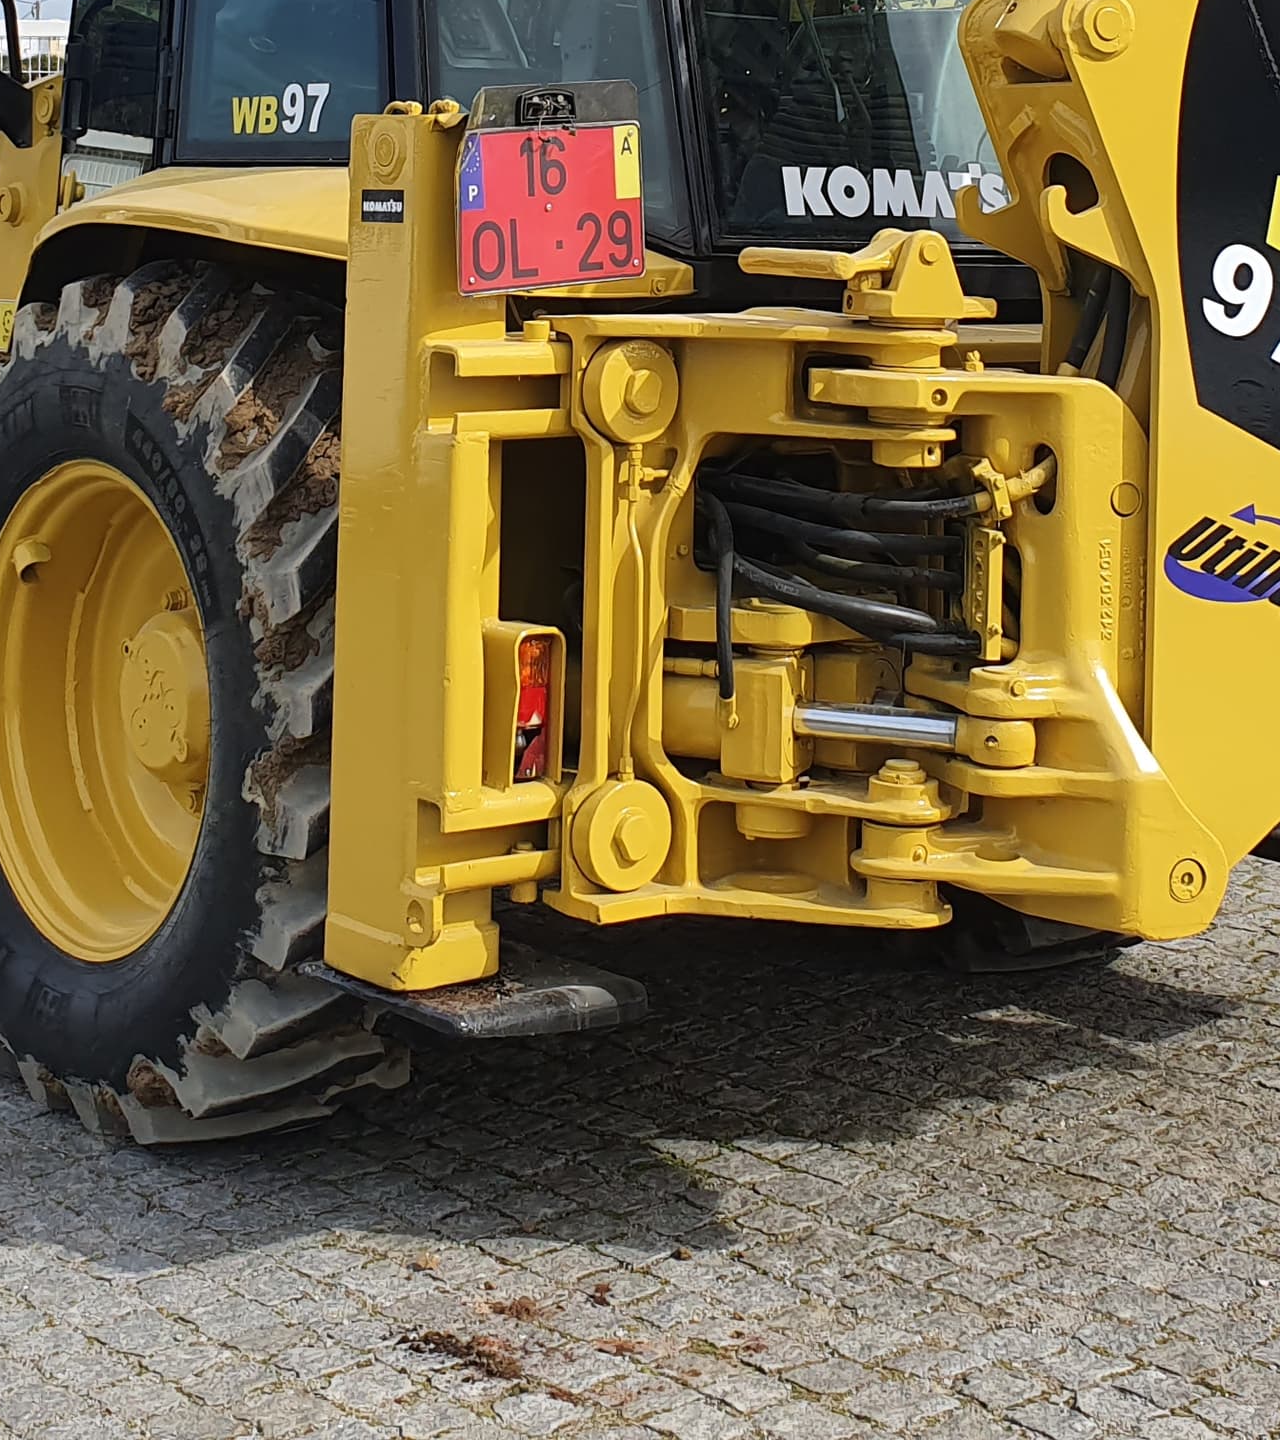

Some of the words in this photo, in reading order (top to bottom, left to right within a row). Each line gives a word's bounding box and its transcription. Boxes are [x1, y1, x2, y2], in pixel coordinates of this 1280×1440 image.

[620, 136, 633, 155] A
[520, 136, 567, 197] 16
[363, 199, 403, 212] KOMATSU
[468, 185, 479, 202] P
[782, 163, 1013, 218] KOMATS
[472, 219, 539, 281] OL
[576, 211, 633, 272] 29
